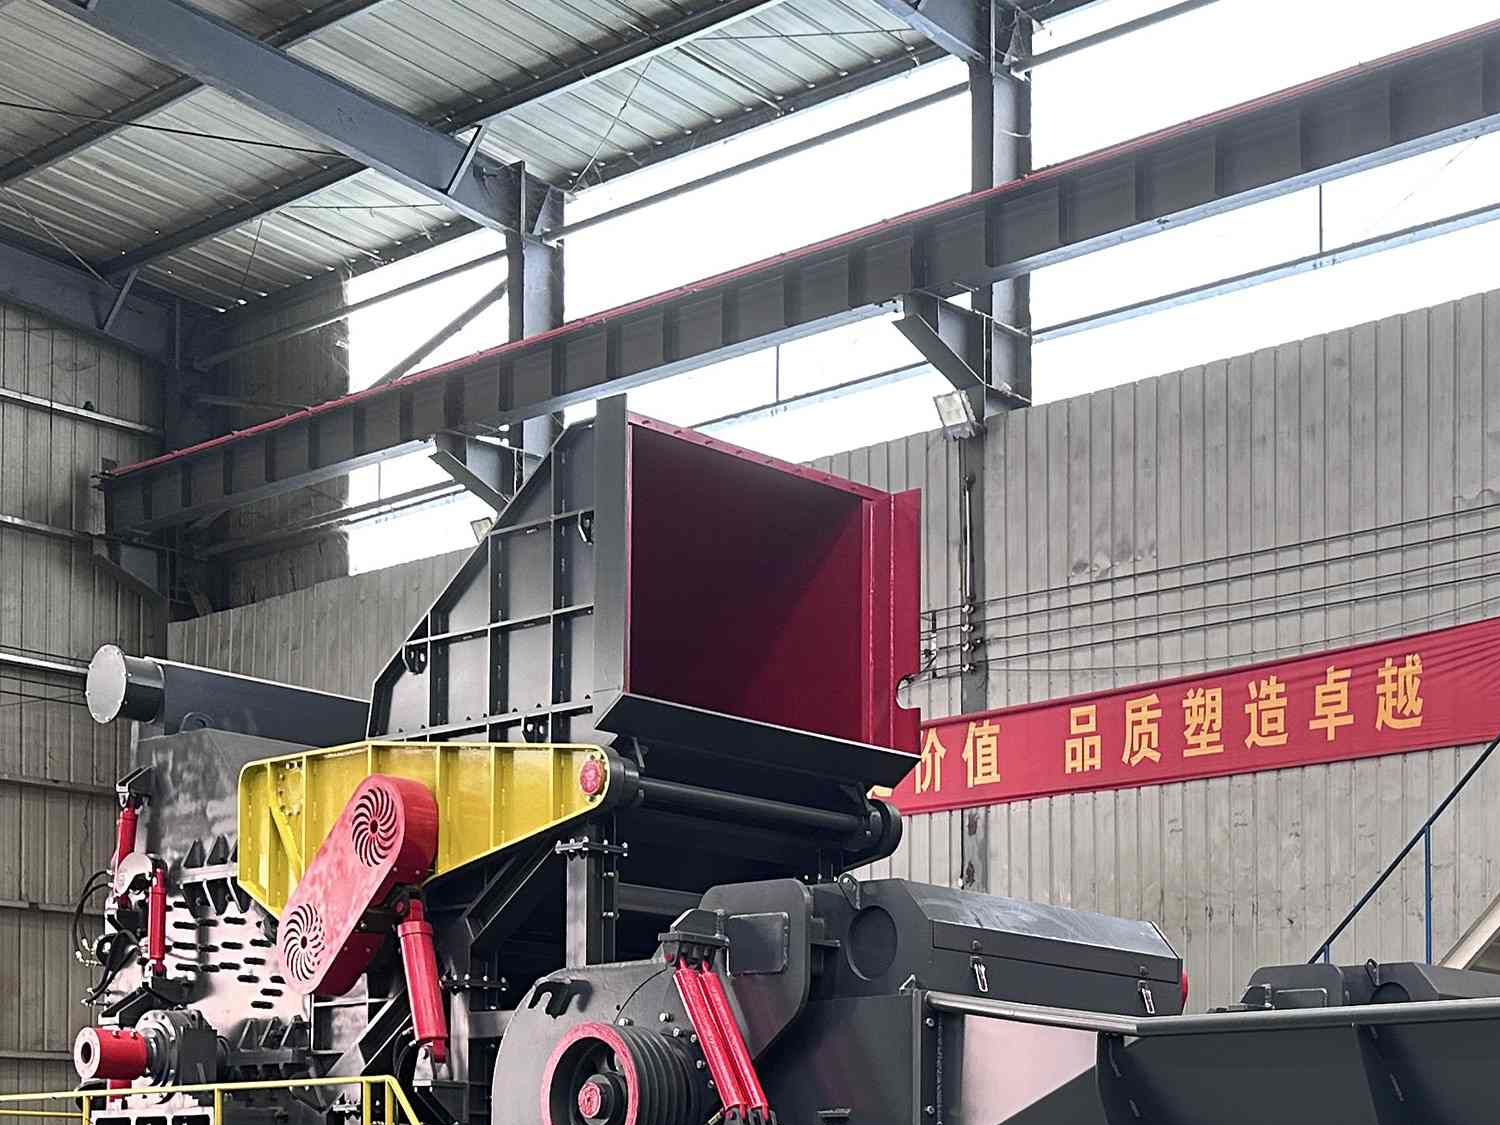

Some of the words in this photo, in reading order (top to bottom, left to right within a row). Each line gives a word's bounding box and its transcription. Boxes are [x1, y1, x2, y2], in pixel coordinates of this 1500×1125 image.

[1065, 654, 1424, 775] 品质塑造卓越
